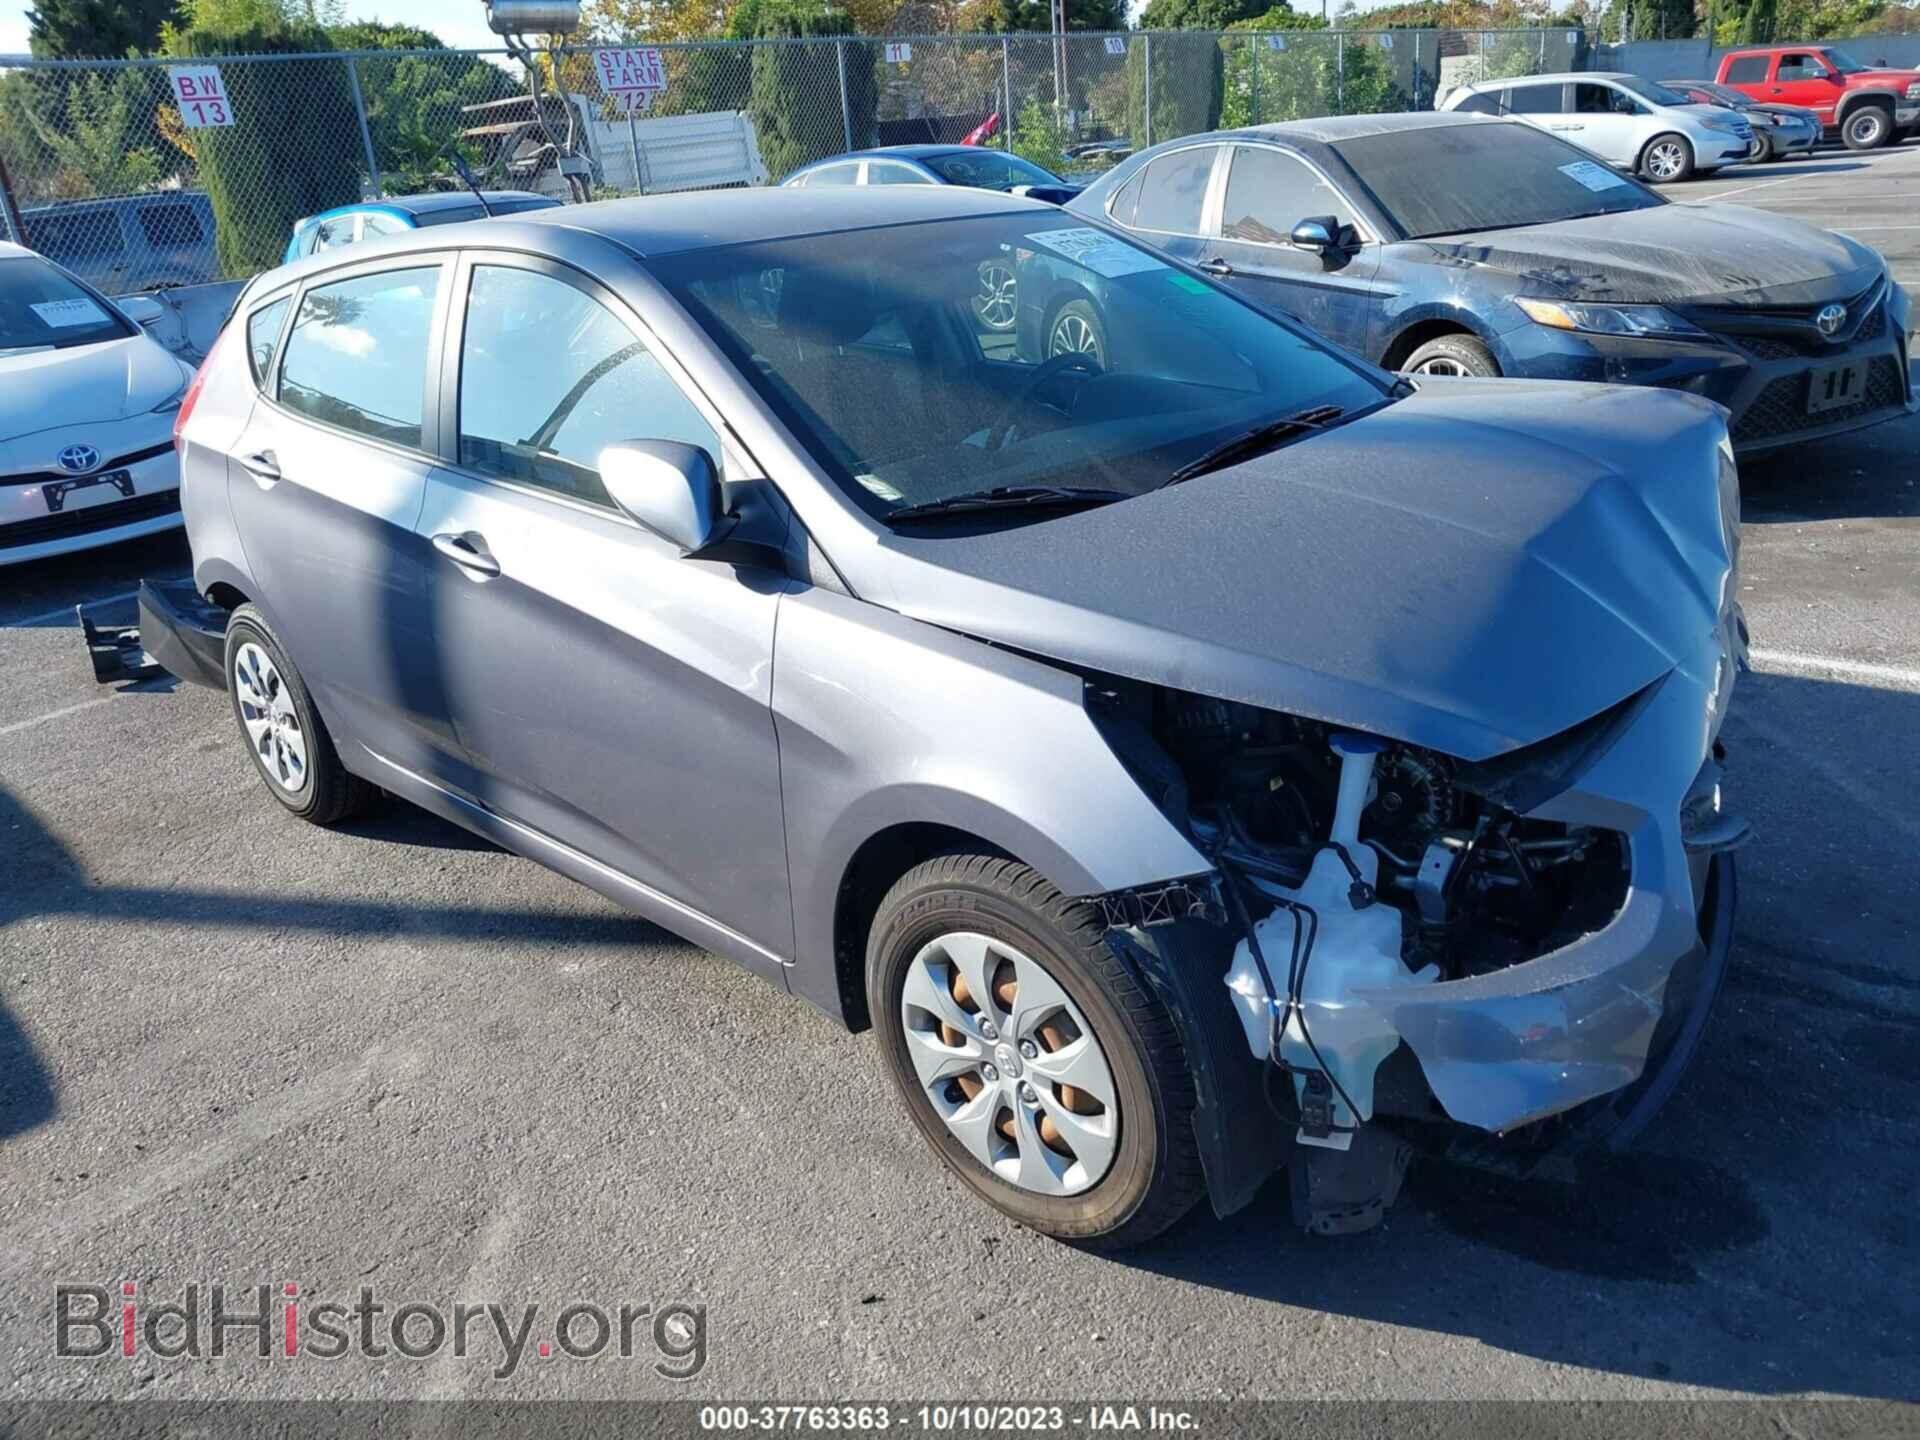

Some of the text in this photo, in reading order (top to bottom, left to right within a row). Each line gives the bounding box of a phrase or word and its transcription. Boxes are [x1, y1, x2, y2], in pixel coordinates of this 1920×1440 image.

[599, 50, 659, 68] STATE
[891, 44, 902, 60] 11
[177, 75, 218, 96] BW
[606, 68, 661, 85] FARM
[624, 92, 646, 110] 12
[192, 102, 226, 124] 13
